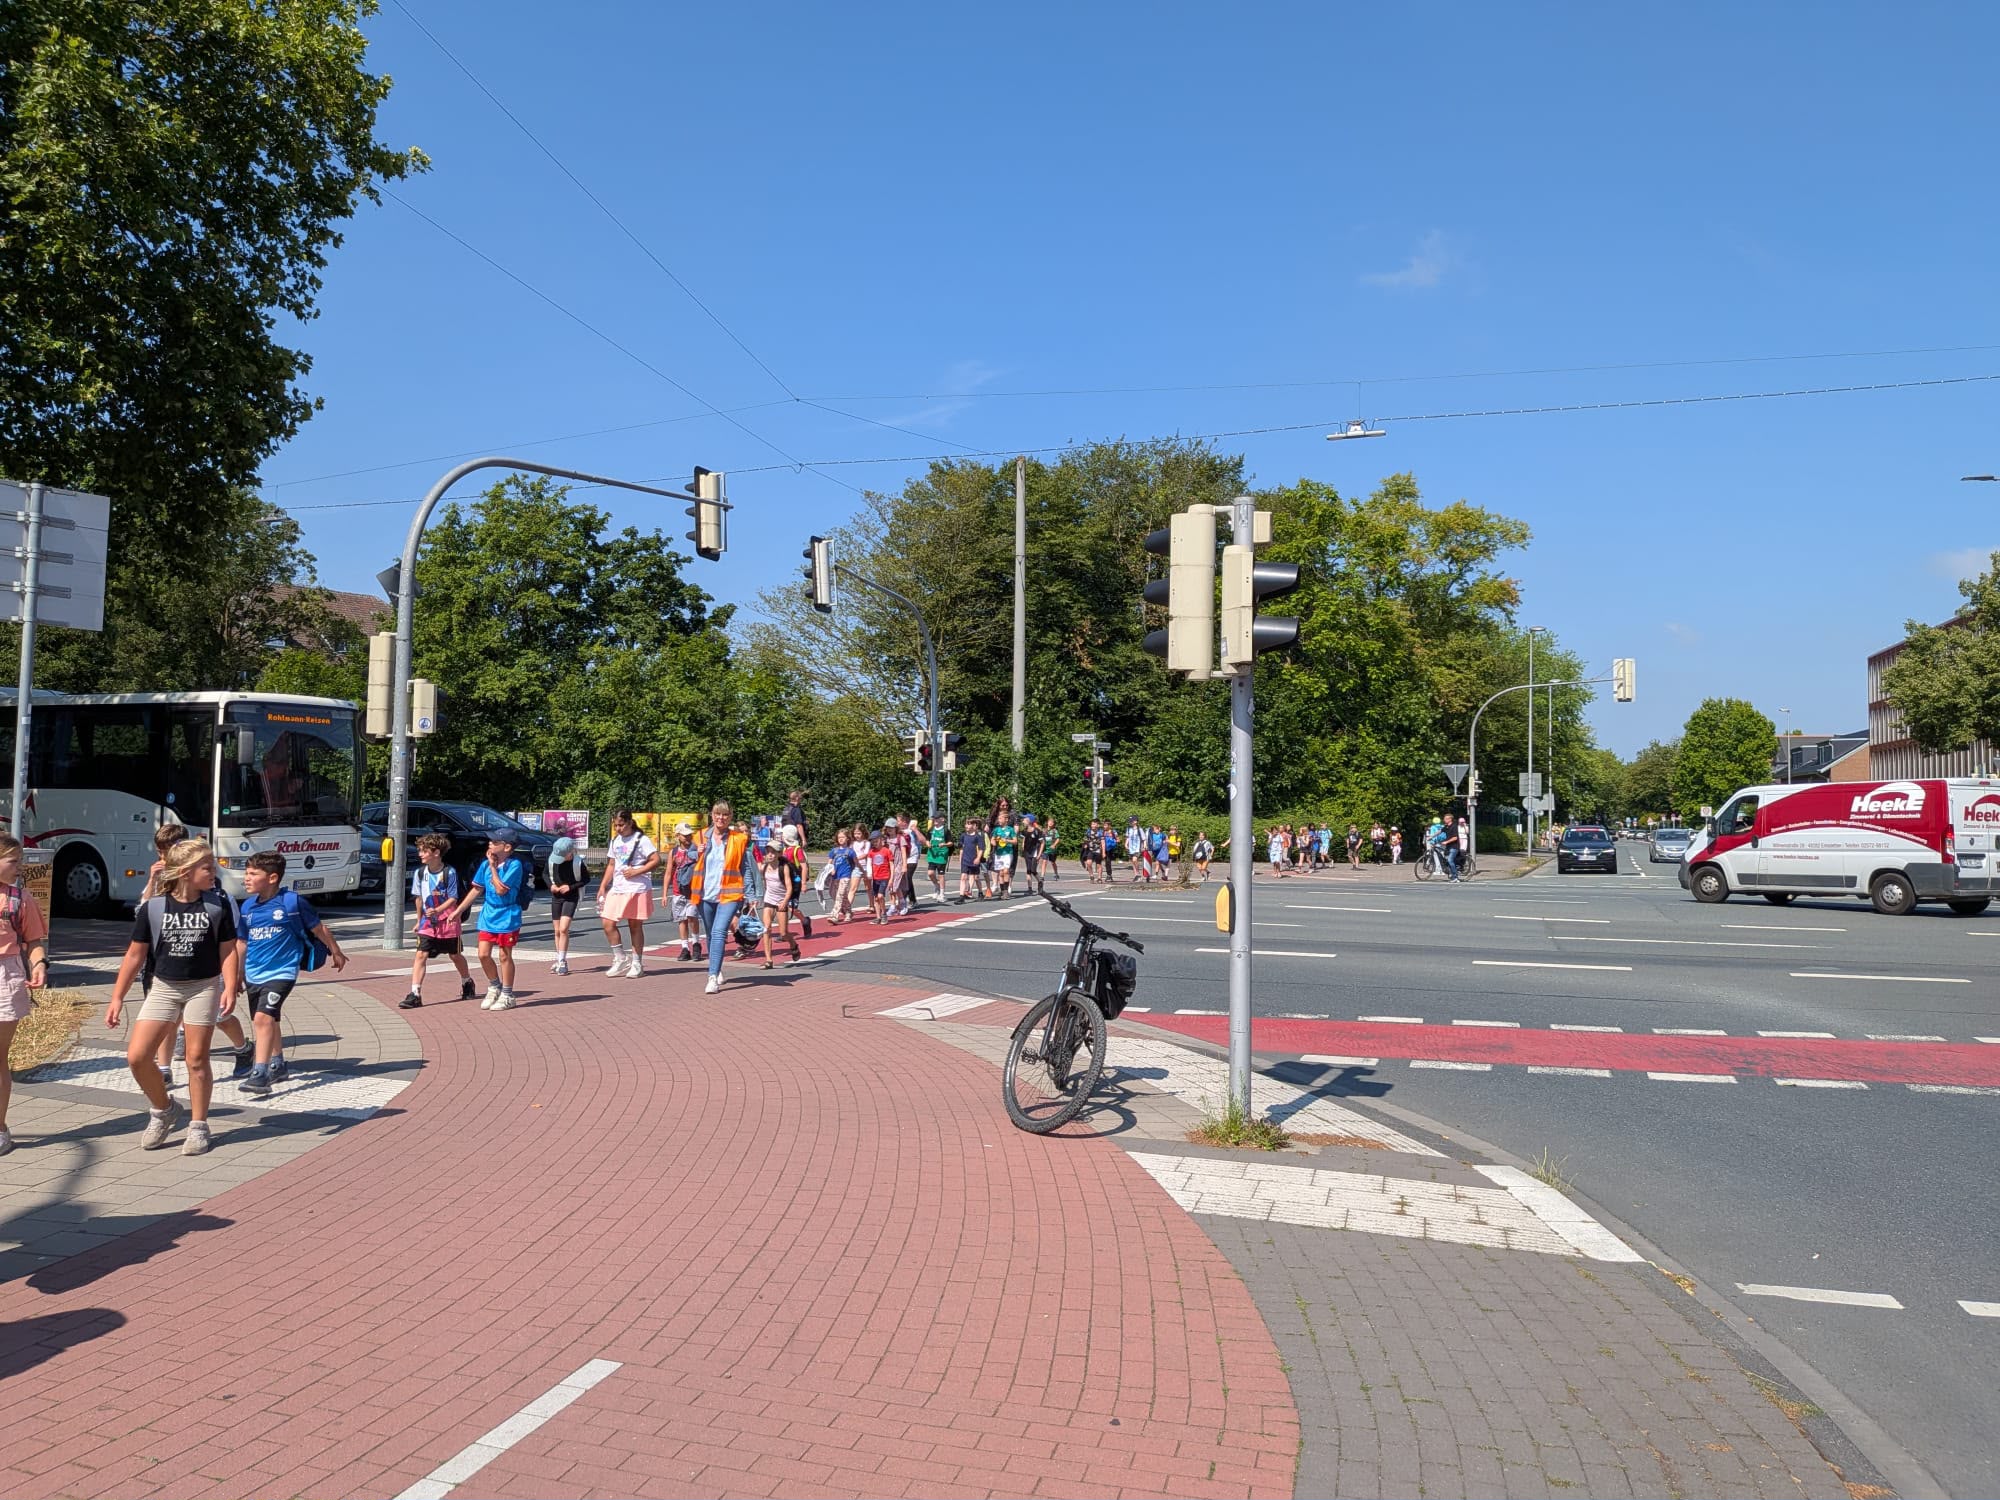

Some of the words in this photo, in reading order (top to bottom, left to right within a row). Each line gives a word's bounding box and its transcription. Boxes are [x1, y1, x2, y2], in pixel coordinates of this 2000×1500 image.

[274, 838, 342, 853] Rohlmann
[161, 911, 210, 930] PARIS
[170, 942, 194, 952] 1993
